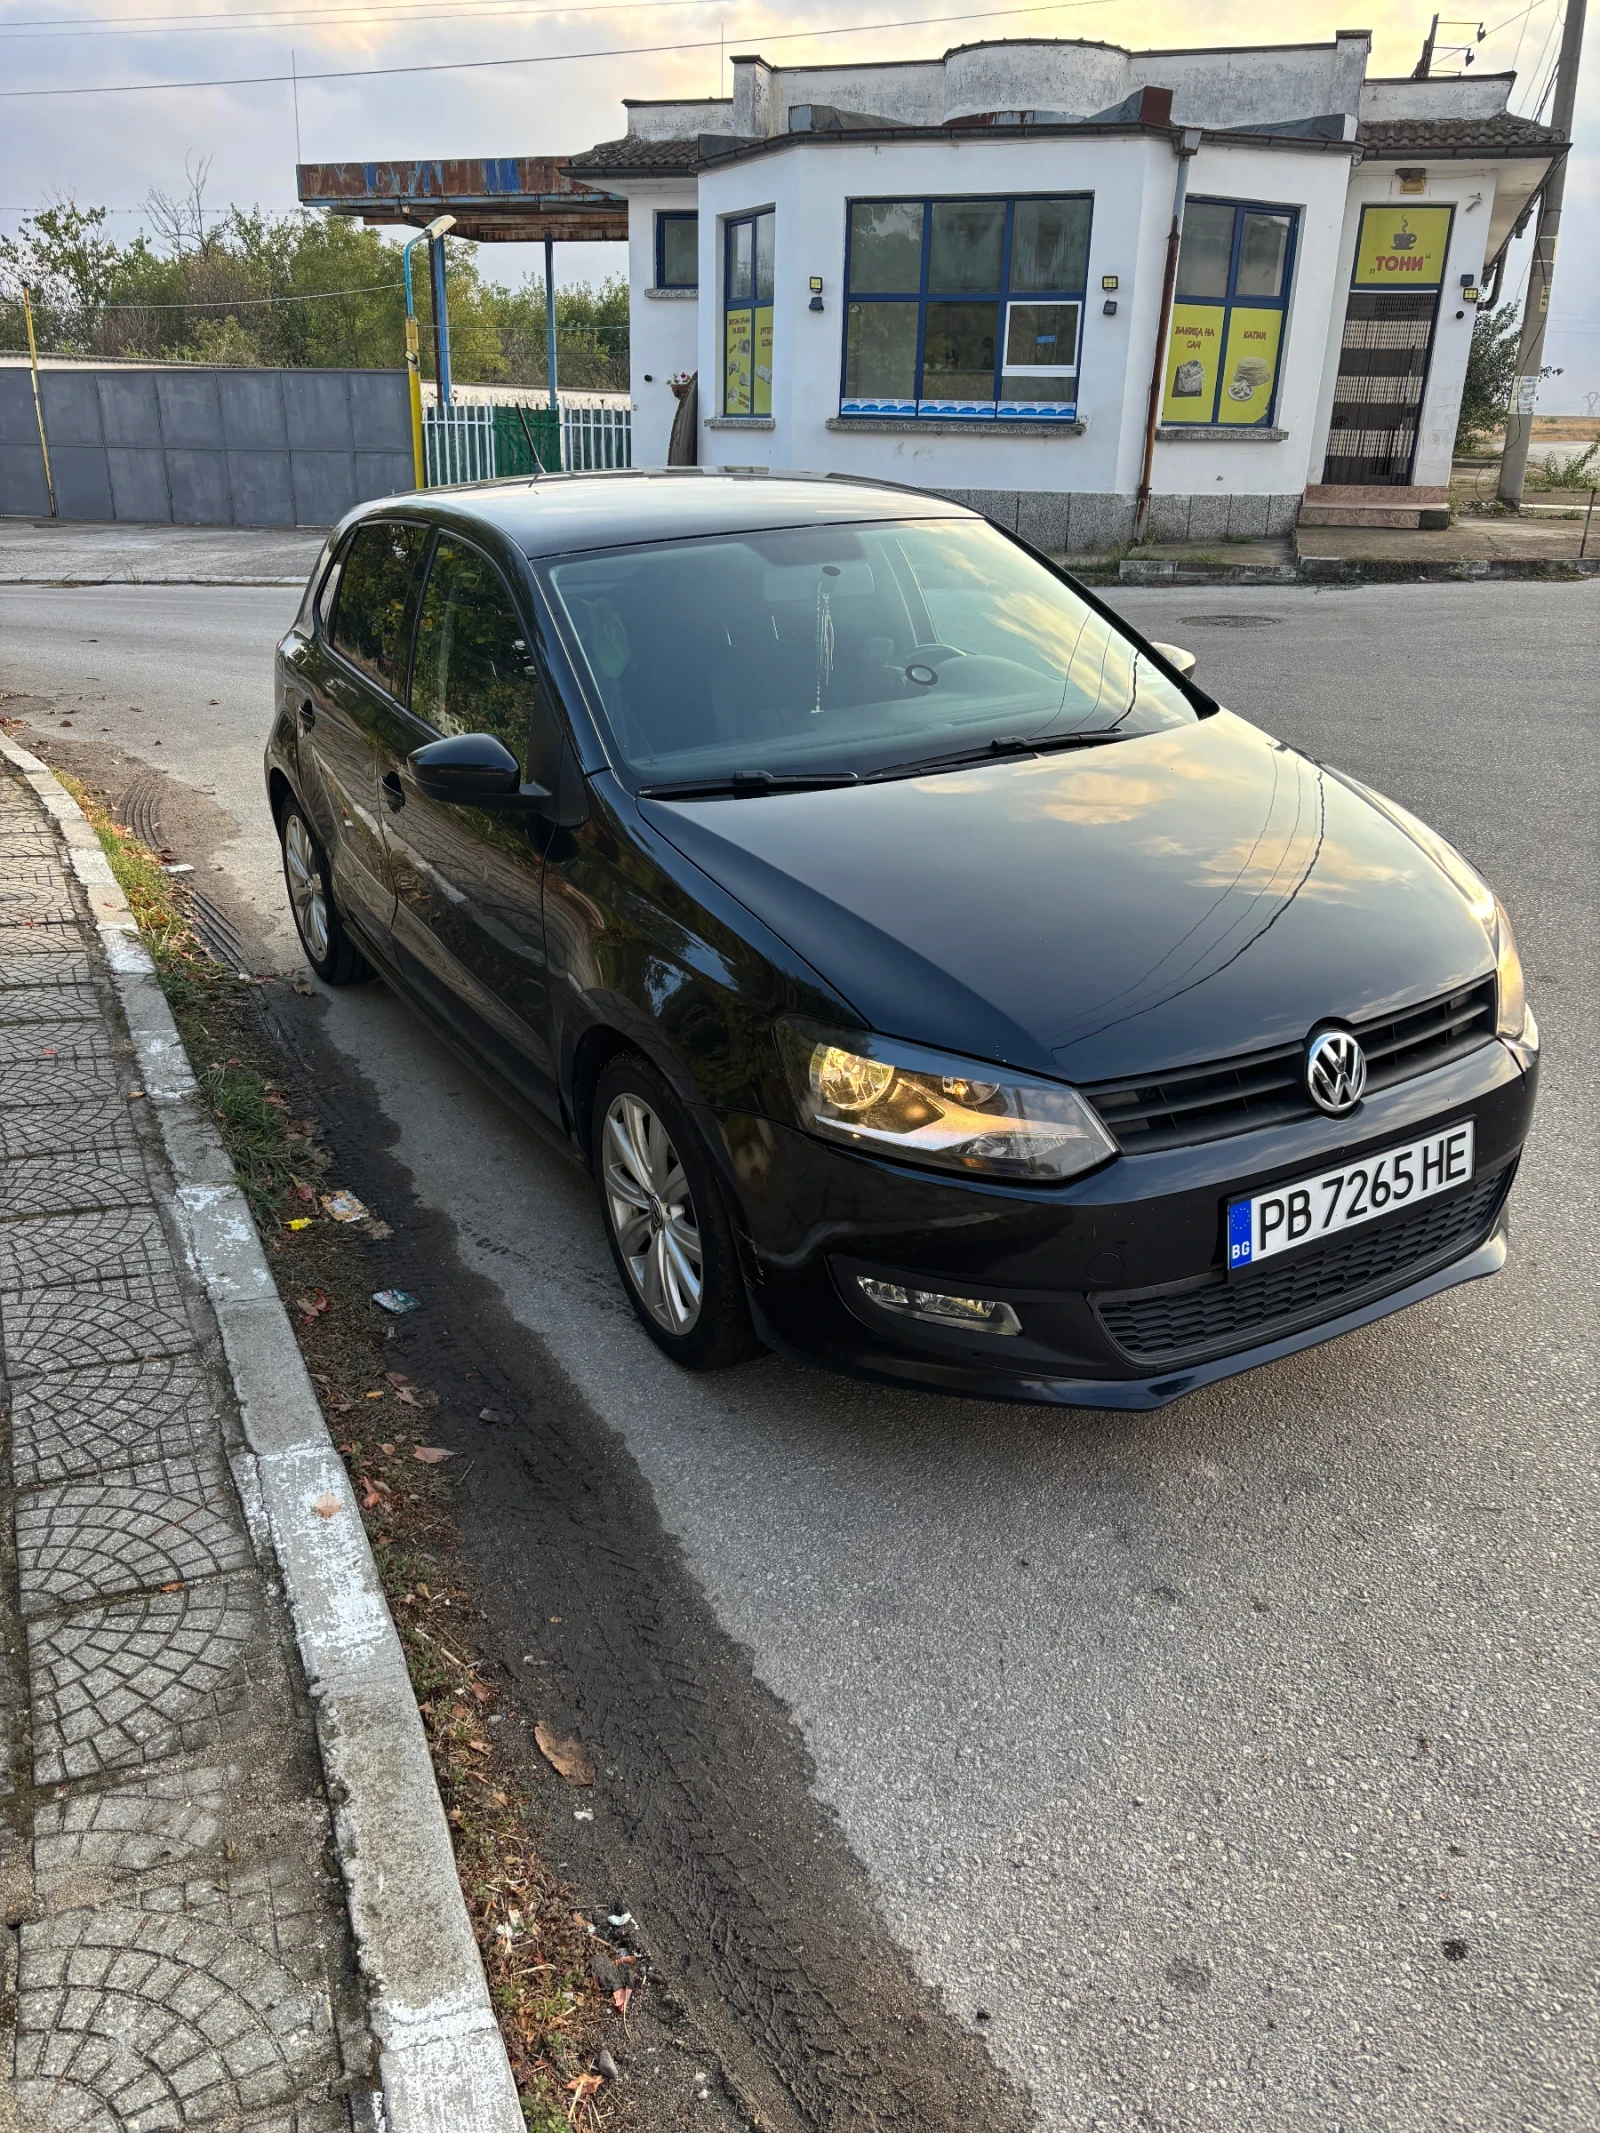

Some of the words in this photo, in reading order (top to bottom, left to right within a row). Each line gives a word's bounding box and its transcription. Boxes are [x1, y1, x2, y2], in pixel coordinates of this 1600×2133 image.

[1204, 328, 1215, 337] НА
[1321, 1151, 1414, 1229] 7265
[1231, 1241, 1250, 1260] BG
